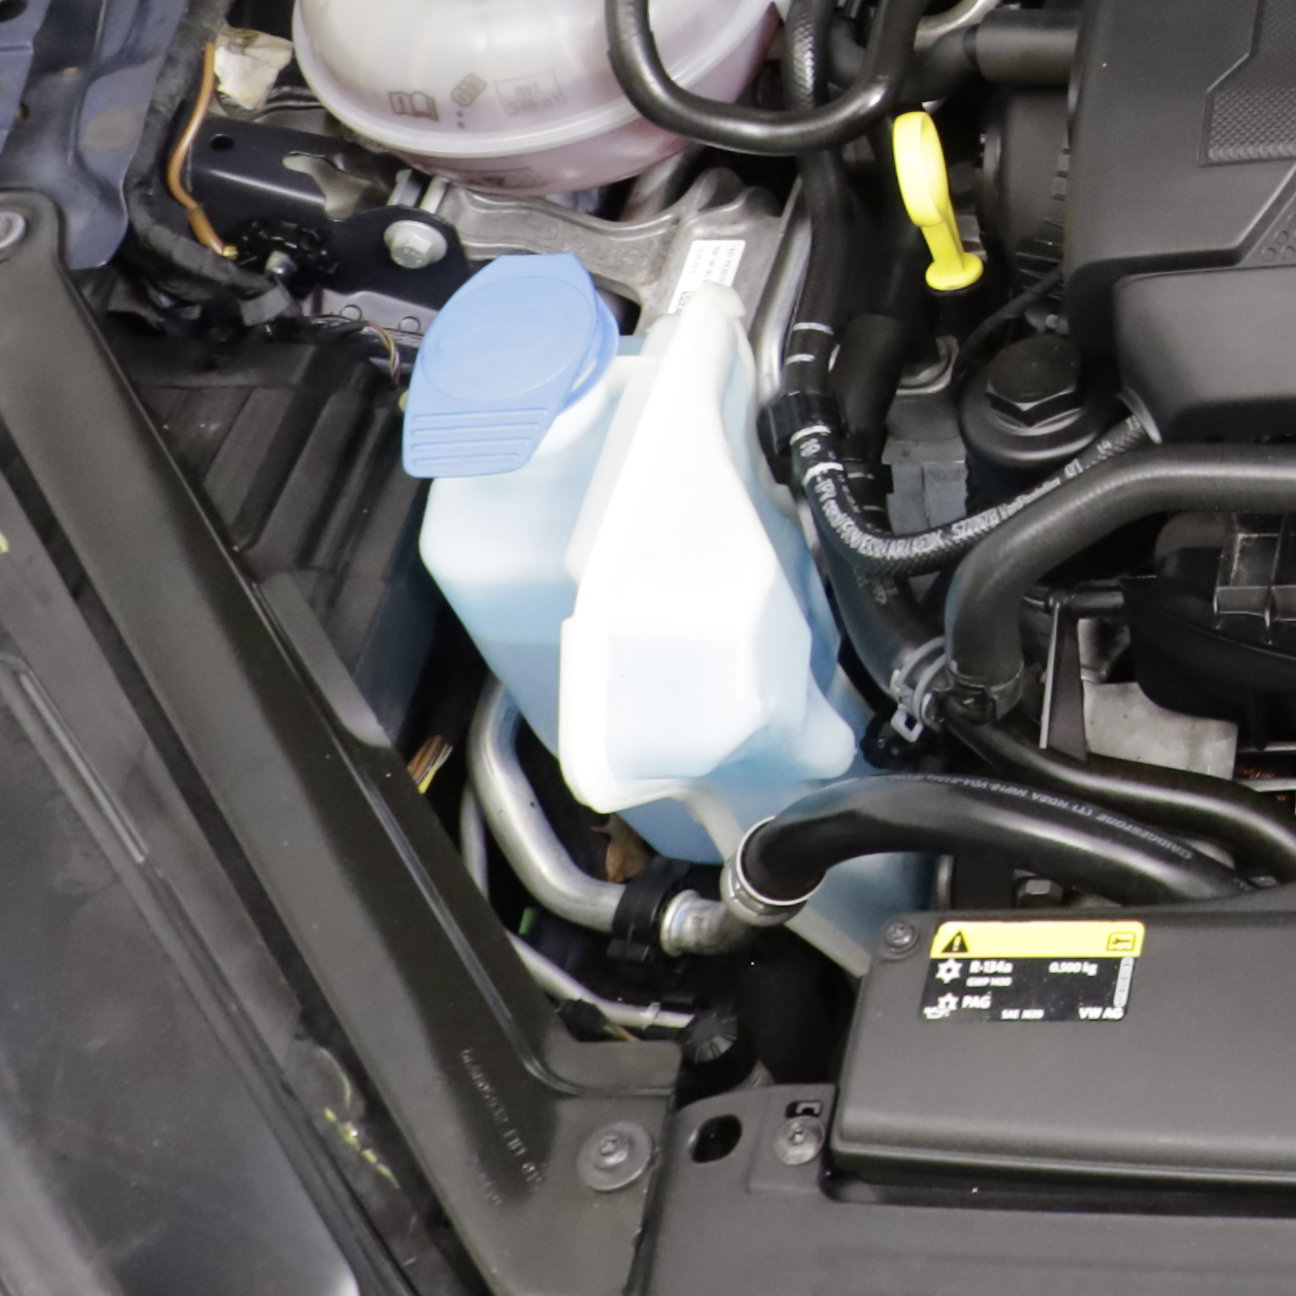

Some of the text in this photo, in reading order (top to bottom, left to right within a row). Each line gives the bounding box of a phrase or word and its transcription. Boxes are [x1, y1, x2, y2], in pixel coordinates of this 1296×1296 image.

[969, 960, 1014, 974] R-134a
[1082, 962, 1099, 977] kg
[961, 994, 992, 1010] PAG
[1077, 1006, 1125, 1020] VW AG
